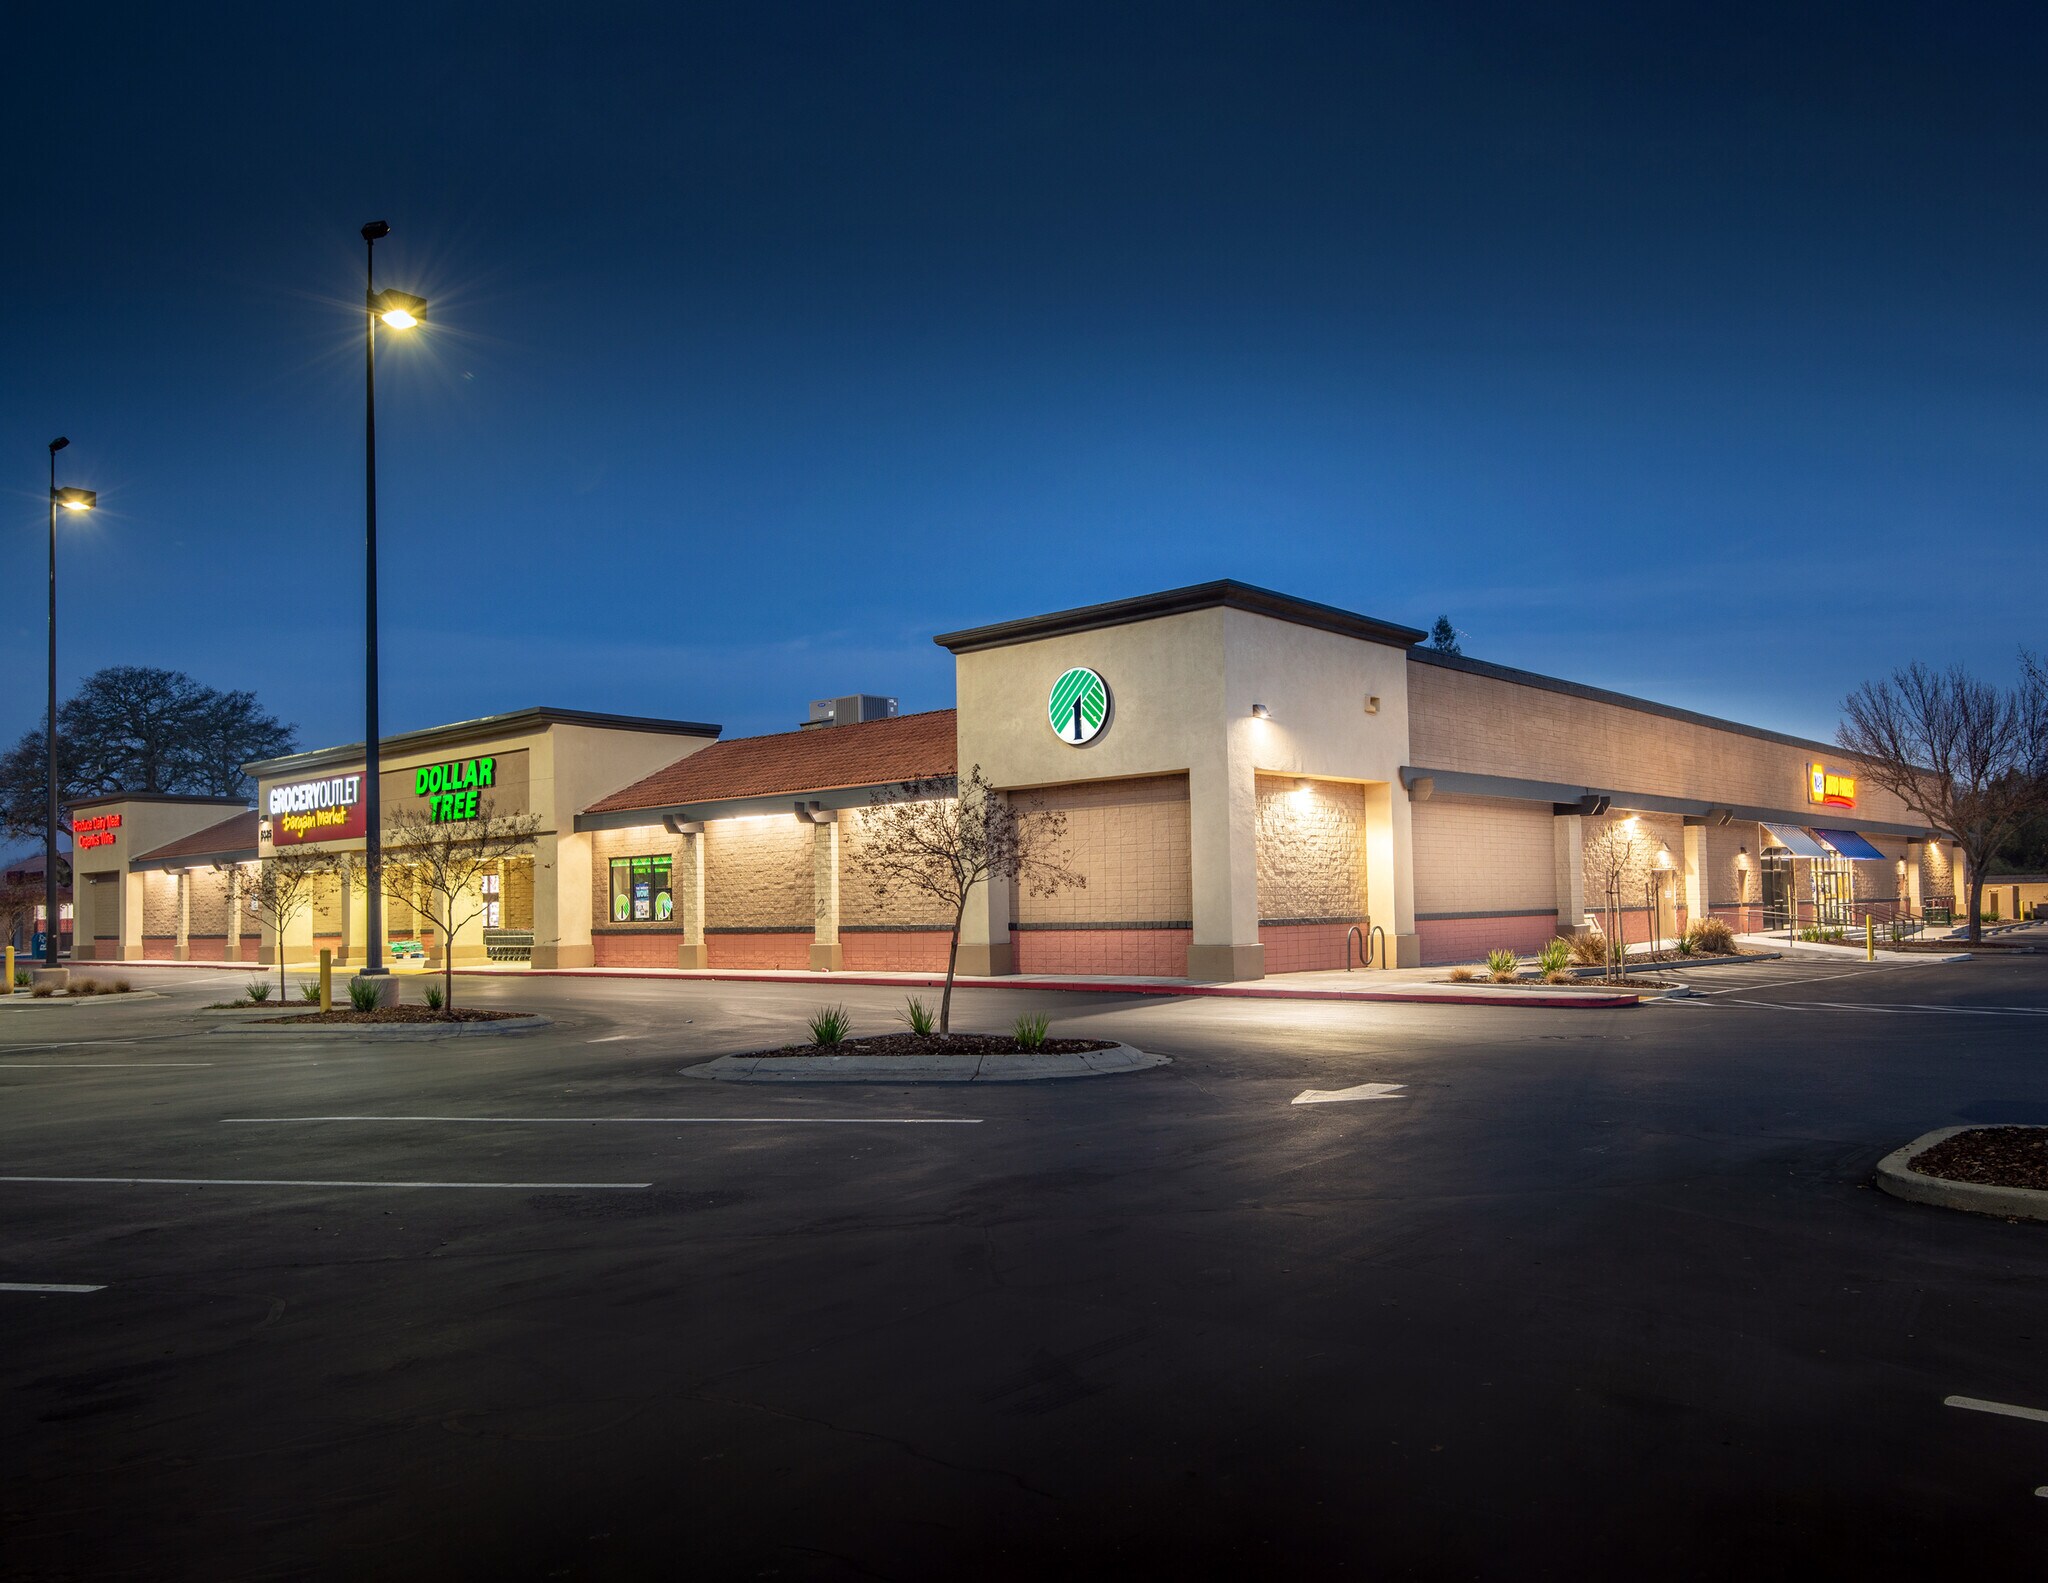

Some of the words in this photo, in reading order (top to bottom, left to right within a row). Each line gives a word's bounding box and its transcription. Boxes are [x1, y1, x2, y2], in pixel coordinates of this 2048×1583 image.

[415, 757, 493, 795] DOLLAR
[282, 810, 316, 838] bargain
[316, 805, 347, 827] market
[429, 790, 478, 822] TREE
